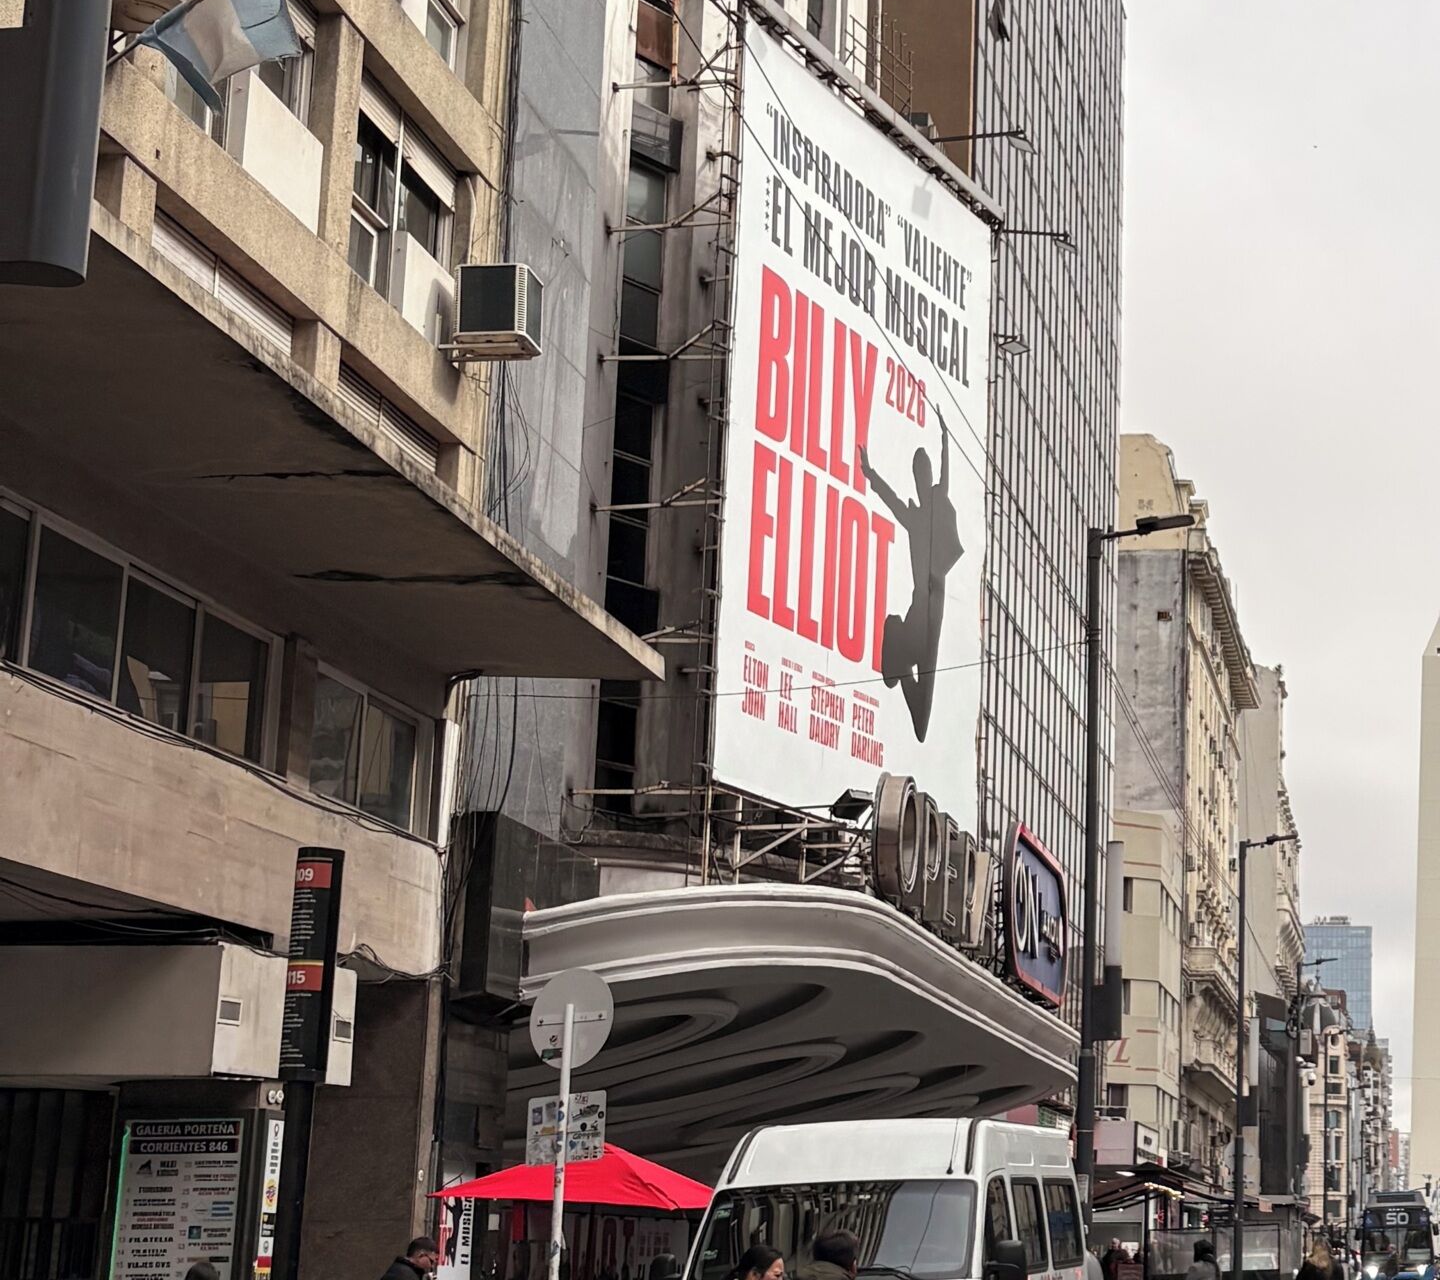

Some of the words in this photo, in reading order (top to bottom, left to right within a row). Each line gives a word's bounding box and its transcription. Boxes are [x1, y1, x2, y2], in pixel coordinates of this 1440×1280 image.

[771, 174, 793, 257] EL
[803, 200, 876, 318] MEJOR
[885, 266, 970, 389] MUSICAL
[755, 263, 879, 496] BILLY
[885, 355, 927, 429] 2026
[747, 440, 895, 674] ELLIOT
[743, 654, 769, 690] ELTON
[779, 670, 793, 701] LEE
[741, 686, 767, 721] JOHN
[778, 701, 798, 734] HALL
[811, 685, 845, 723] STEPHEN
[852, 703, 875, 735] PETER
[809, 713, 841, 750] DALDRY
[851, 731, 884, 768] DARLING
[136, 1125, 181, 1136] GALERIA
[184, 1121, 235, 1135] PORTEÑA
[140, 1142, 206, 1153] CORRIENTES
[209, 1141, 228, 1152] 846
[1386, 1212, 1409, 1225] 50
